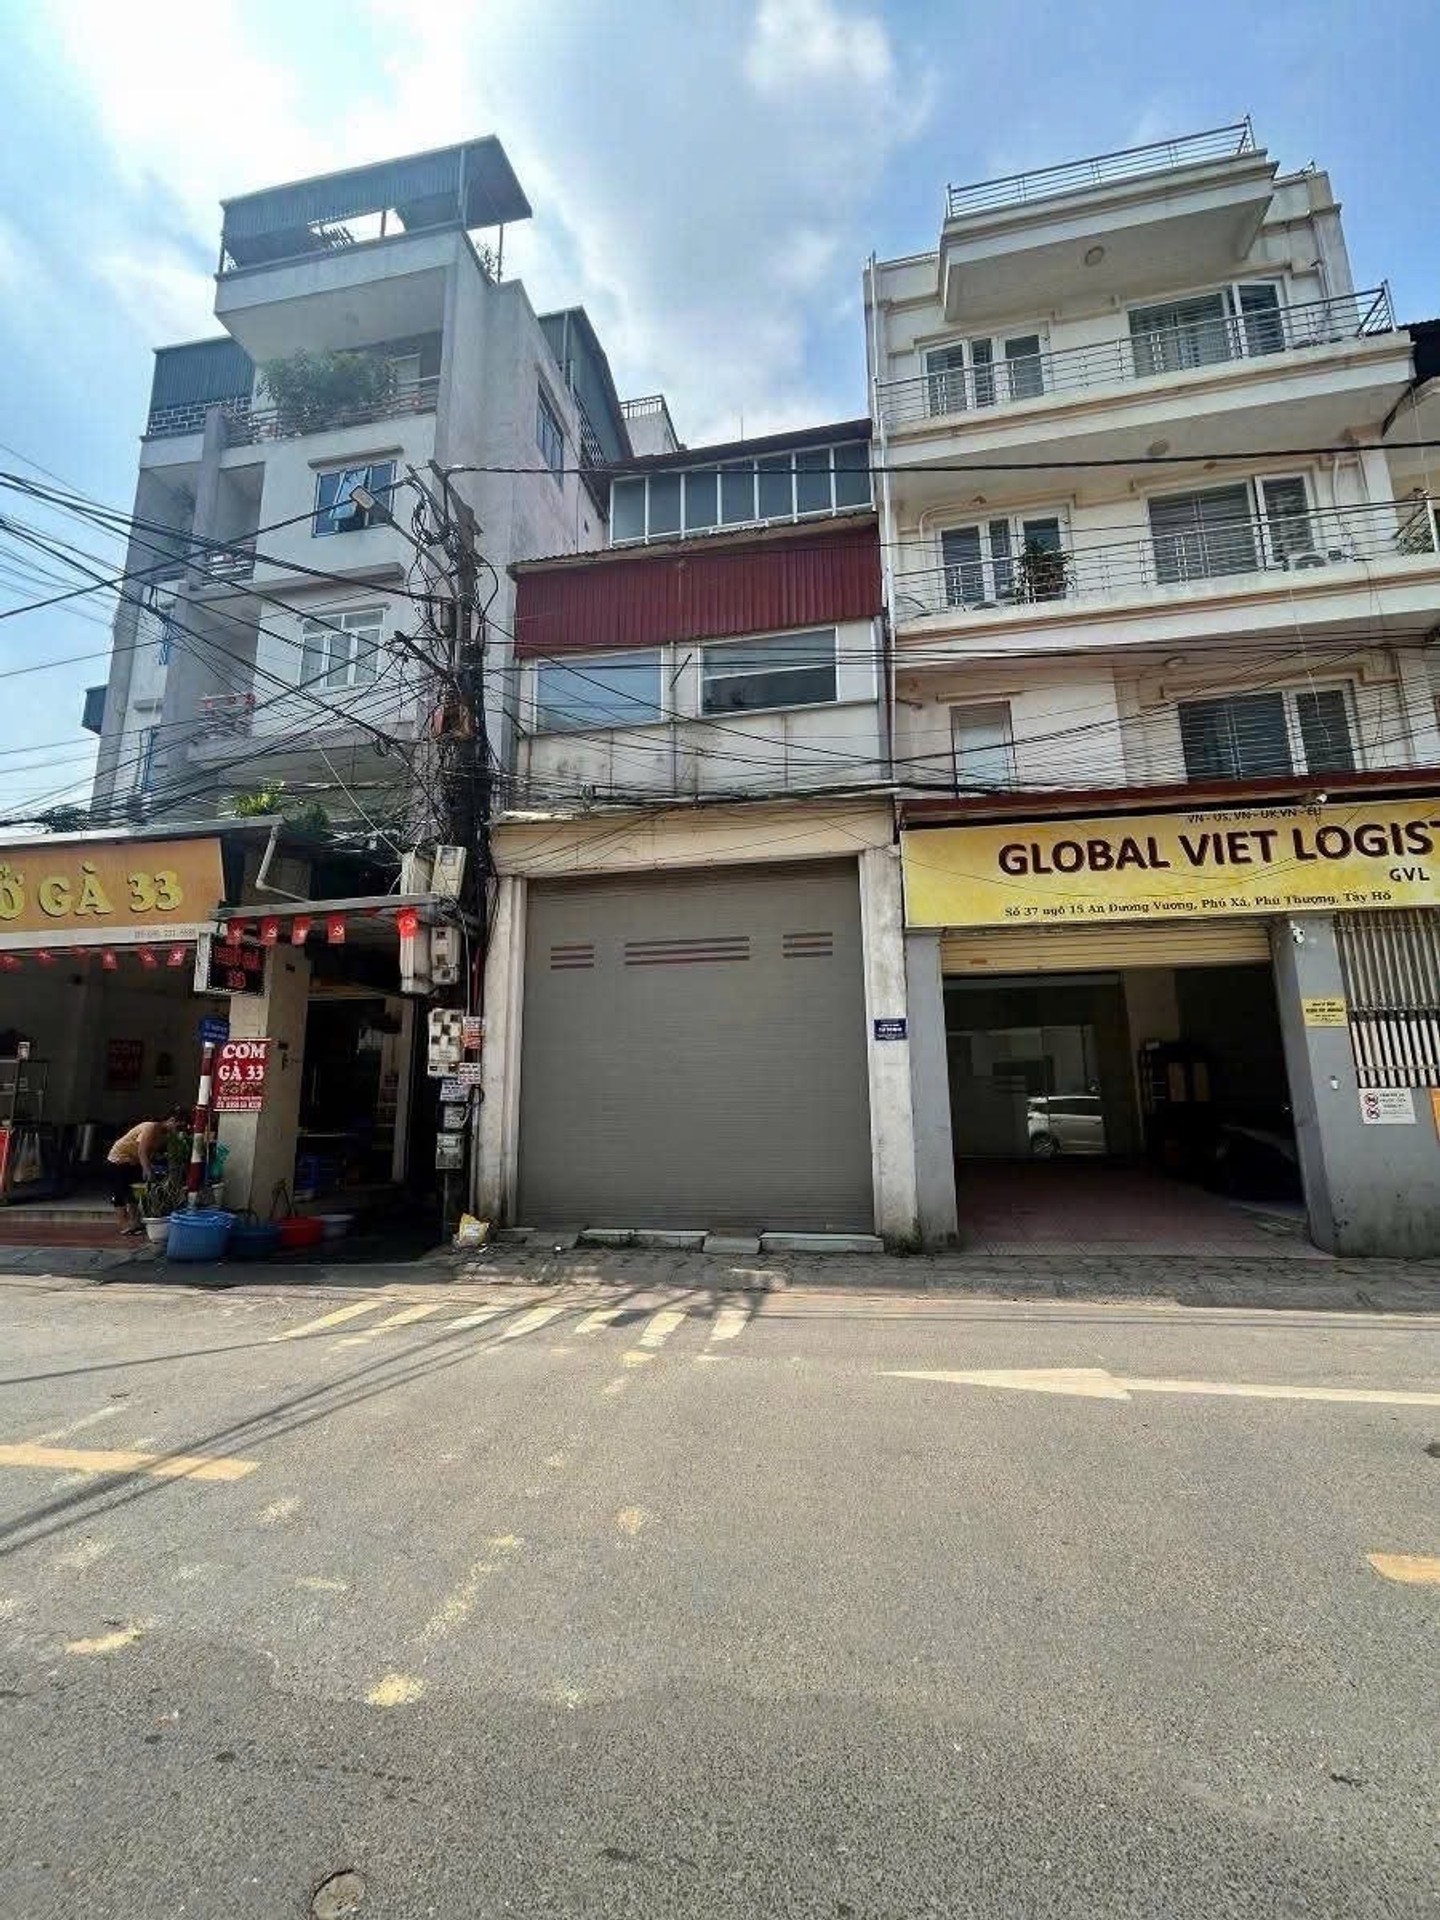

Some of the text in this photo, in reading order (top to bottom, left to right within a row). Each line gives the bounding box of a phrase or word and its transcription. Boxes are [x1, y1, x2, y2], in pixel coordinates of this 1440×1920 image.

[998, 820, 1440, 876] GLOBAL VIET LOGIS
[1389, 867, 1430, 882] GVL
[38, 858, 114, 918] GÀ
[127, 869, 184, 913] 33
[1024, 907, 1039, 917] 37
[1069, 904, 1085, 915] 15
[1088, 904, 1105, 914] An
[222, 1041, 266, 1059] CƠM
[218, 1061, 265, 1081] GÀ 33
